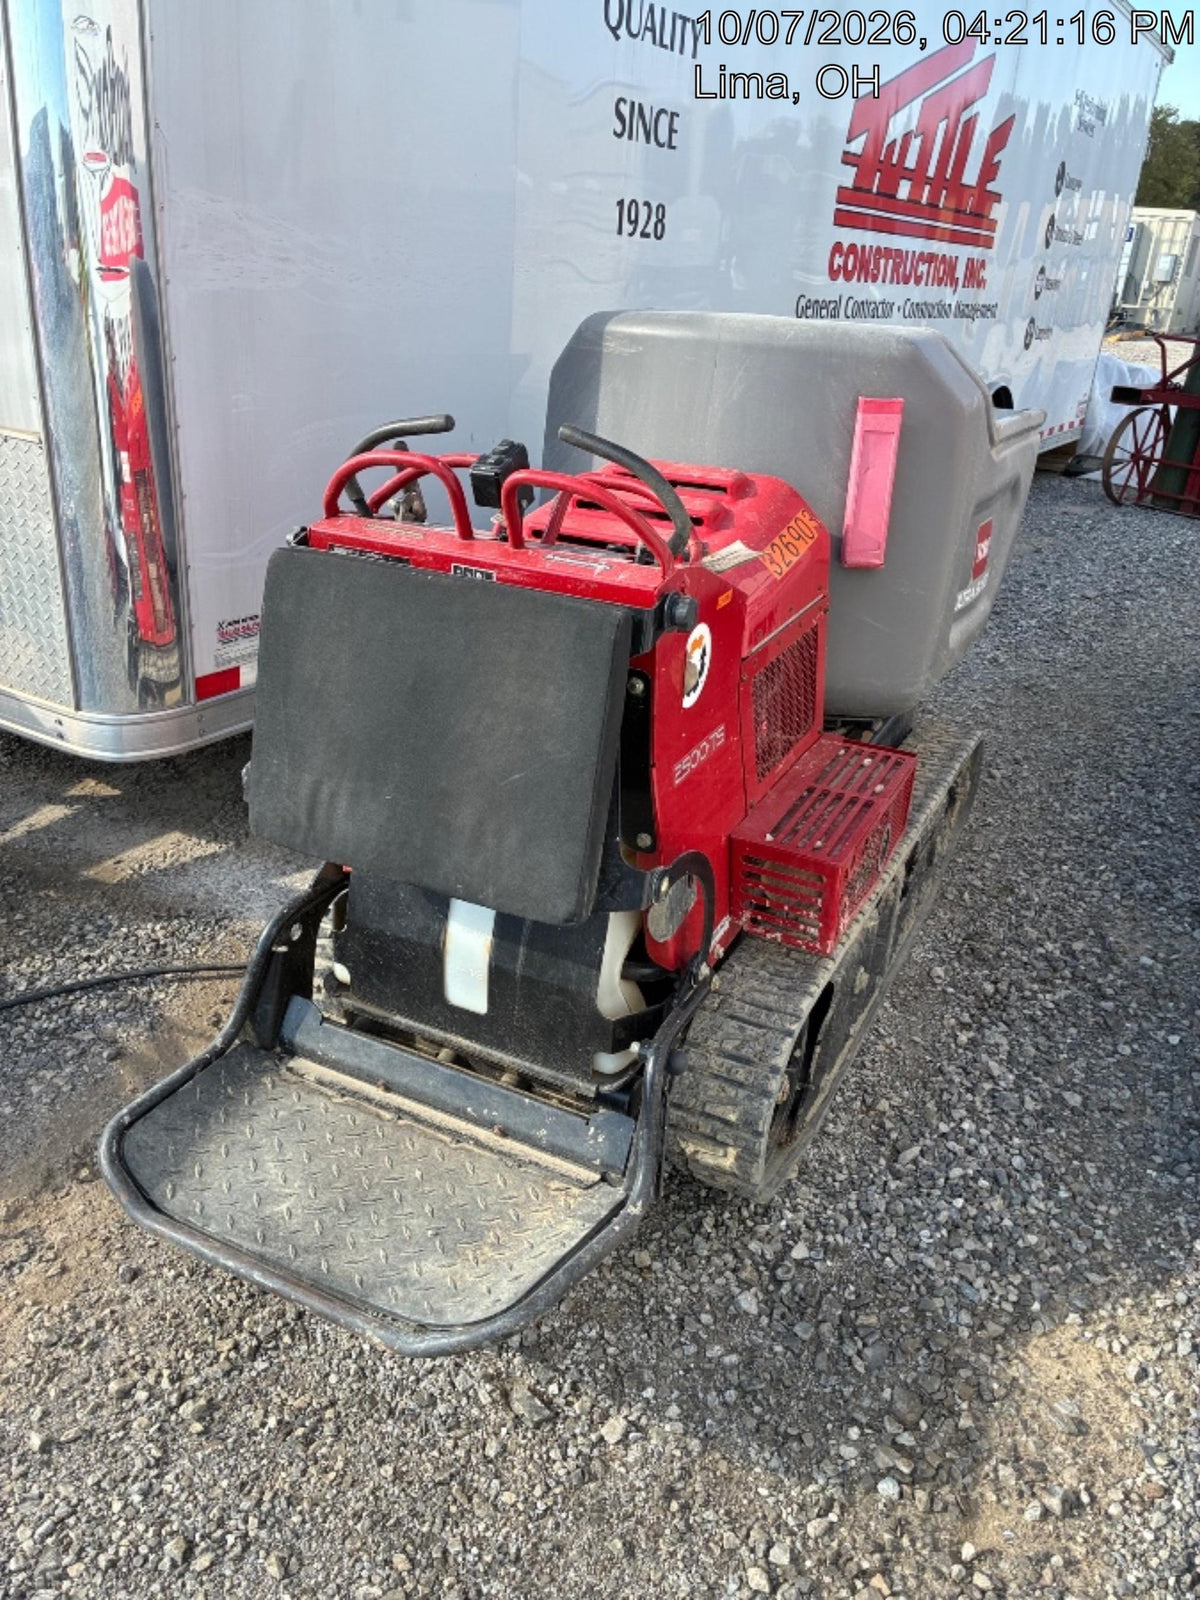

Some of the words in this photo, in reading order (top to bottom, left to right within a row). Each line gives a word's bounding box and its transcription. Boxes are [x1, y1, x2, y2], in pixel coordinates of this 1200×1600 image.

[604, 0, 702, 59] QUALITY
[613, 97, 680, 150] SINCE
[616, 198, 667, 241] 1928
[828, 241, 960, 294] CONSTRUCTION,
[961, 257, 988, 290] INC.
[796, 294, 842, 319] General
[844, 296, 896, 319] Contractor
[902, 298, 951, 319] Construction
[953, 300, 1000, 322] Management
